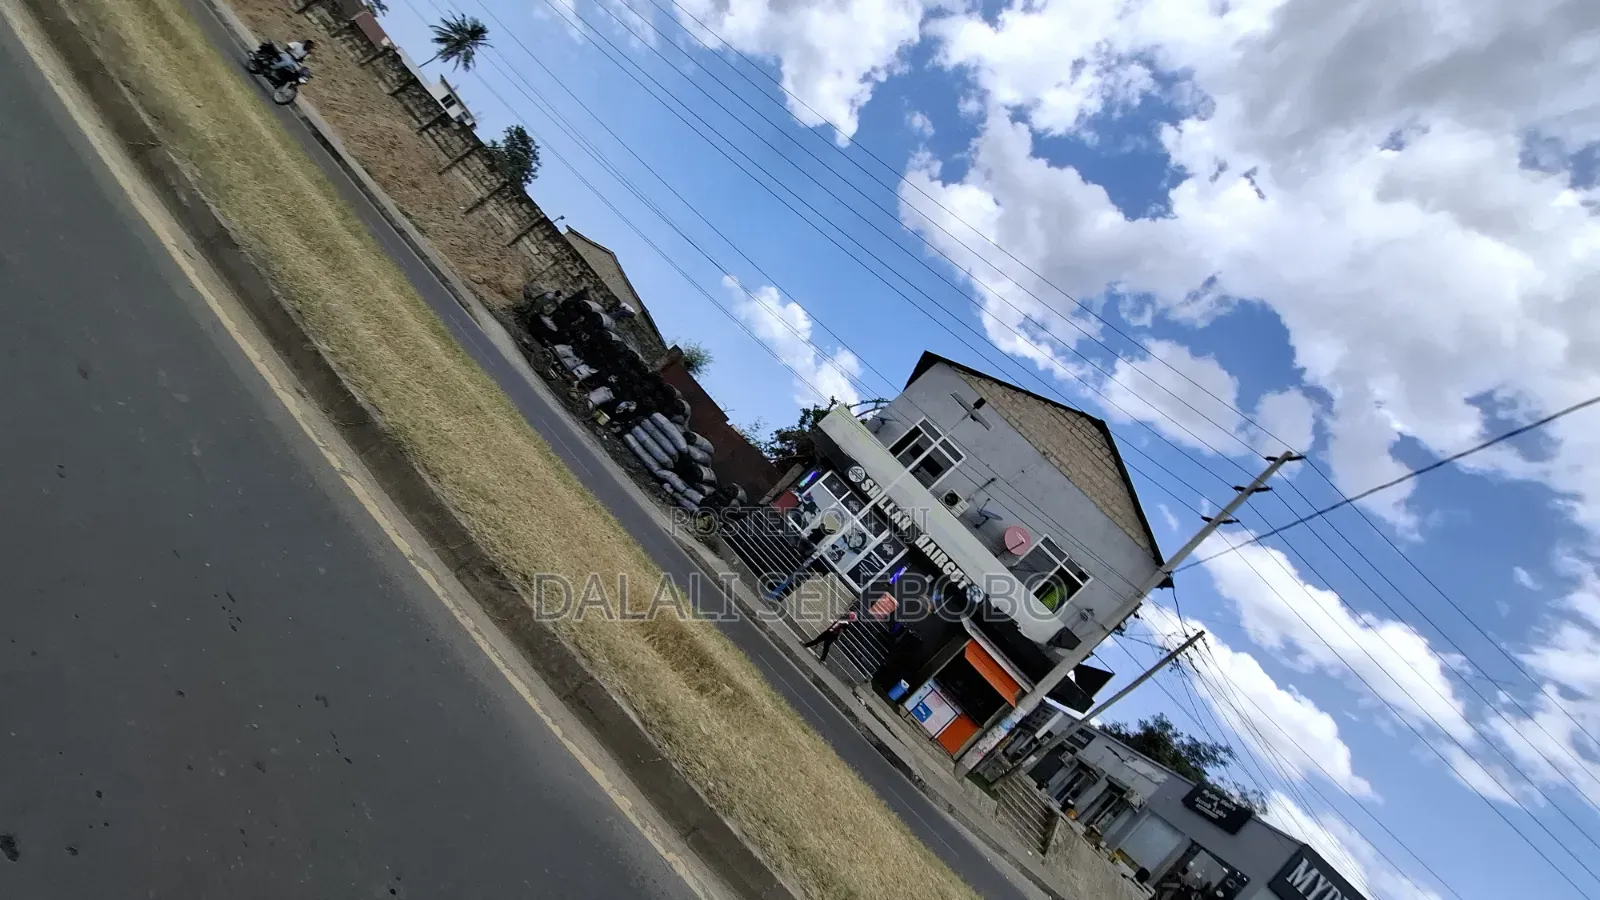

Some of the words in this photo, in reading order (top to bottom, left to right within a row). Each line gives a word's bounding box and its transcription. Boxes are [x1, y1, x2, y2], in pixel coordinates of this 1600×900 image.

[860, 479, 913, 531] SHLLAH
[914, 533, 974, 590] HAIRCUT
[1285, 857, 1349, 900] MYD
